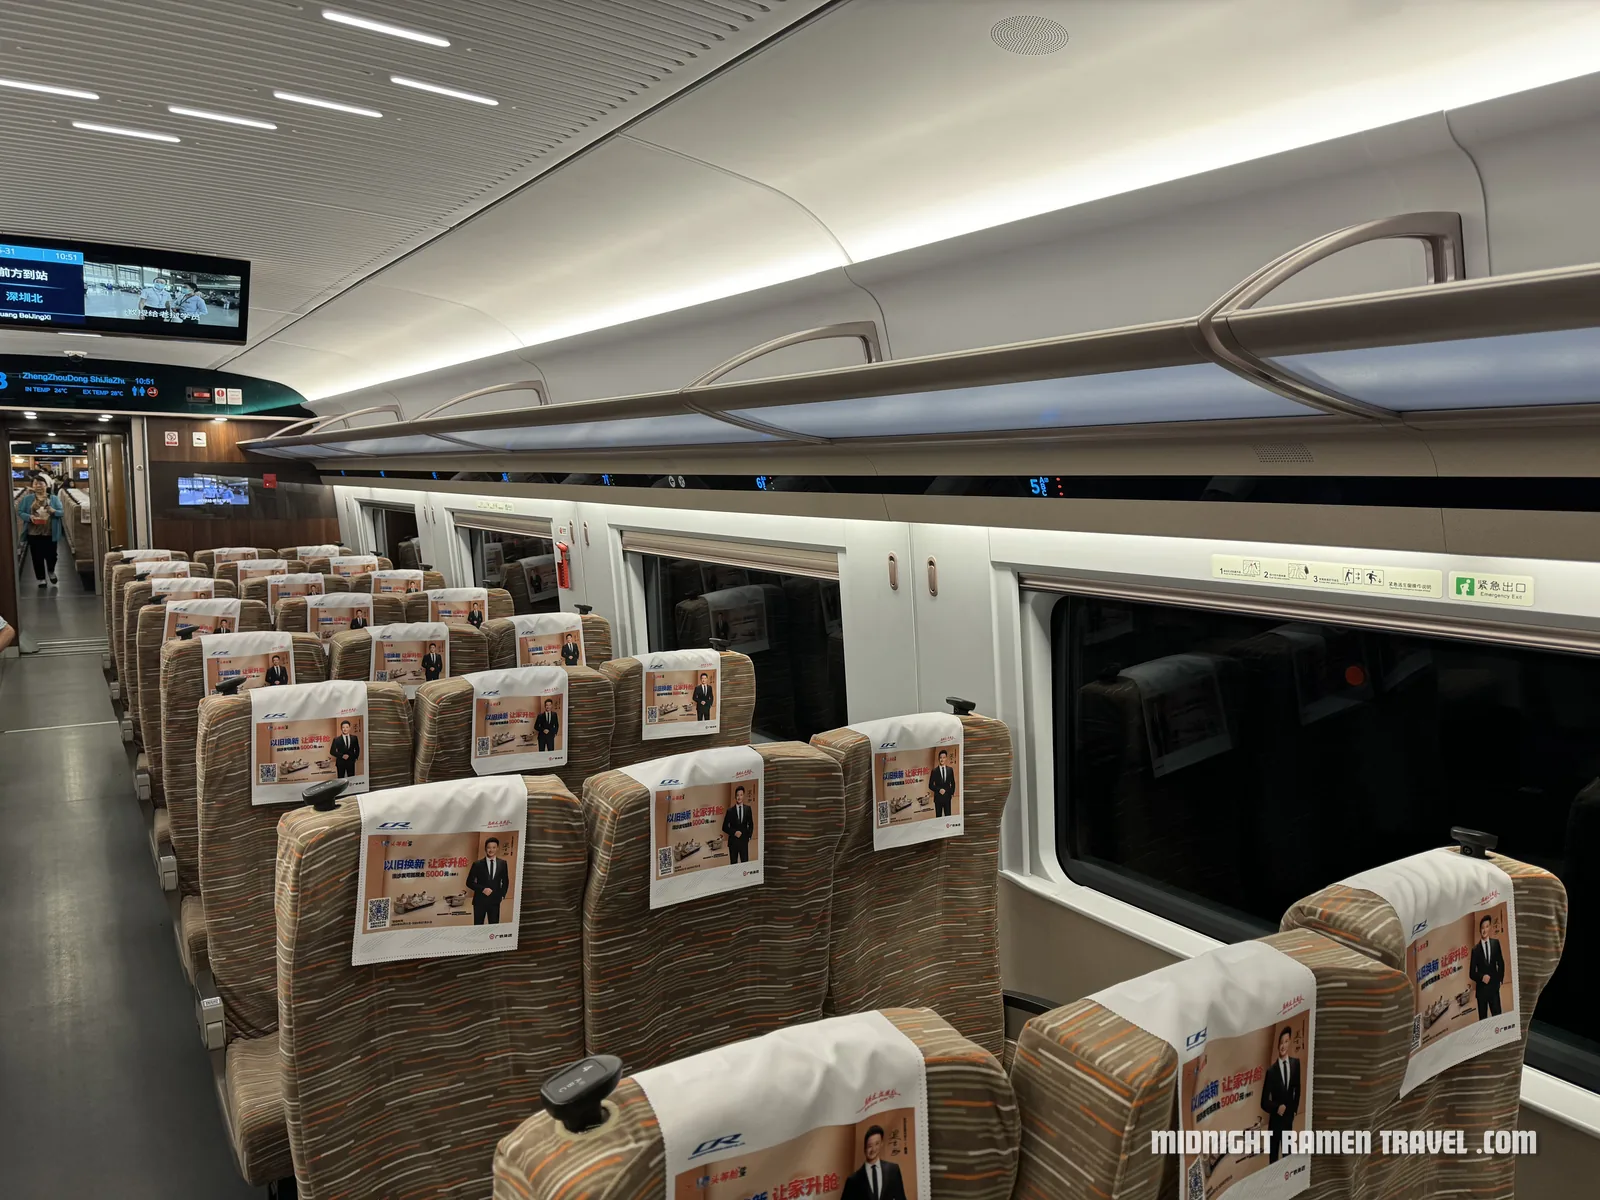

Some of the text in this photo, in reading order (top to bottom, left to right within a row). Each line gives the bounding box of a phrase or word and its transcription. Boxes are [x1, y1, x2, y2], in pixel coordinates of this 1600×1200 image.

[56, 252, 77, 261] 10:51
[0, 267, 48, 281] 前方到站
[6, 291, 43, 303] 深圳北
[22, 372, 88, 383] ZhengZhouDong
[1030, 479, 1040, 494] 5
[384, 857, 468, 871] 以旧换新 让家升舱
[1221, 1065, 1263, 1092] 让家升舱
[692, 1133, 742, 1155] CR
[772, 1173, 839, 1200] 让家升舱
